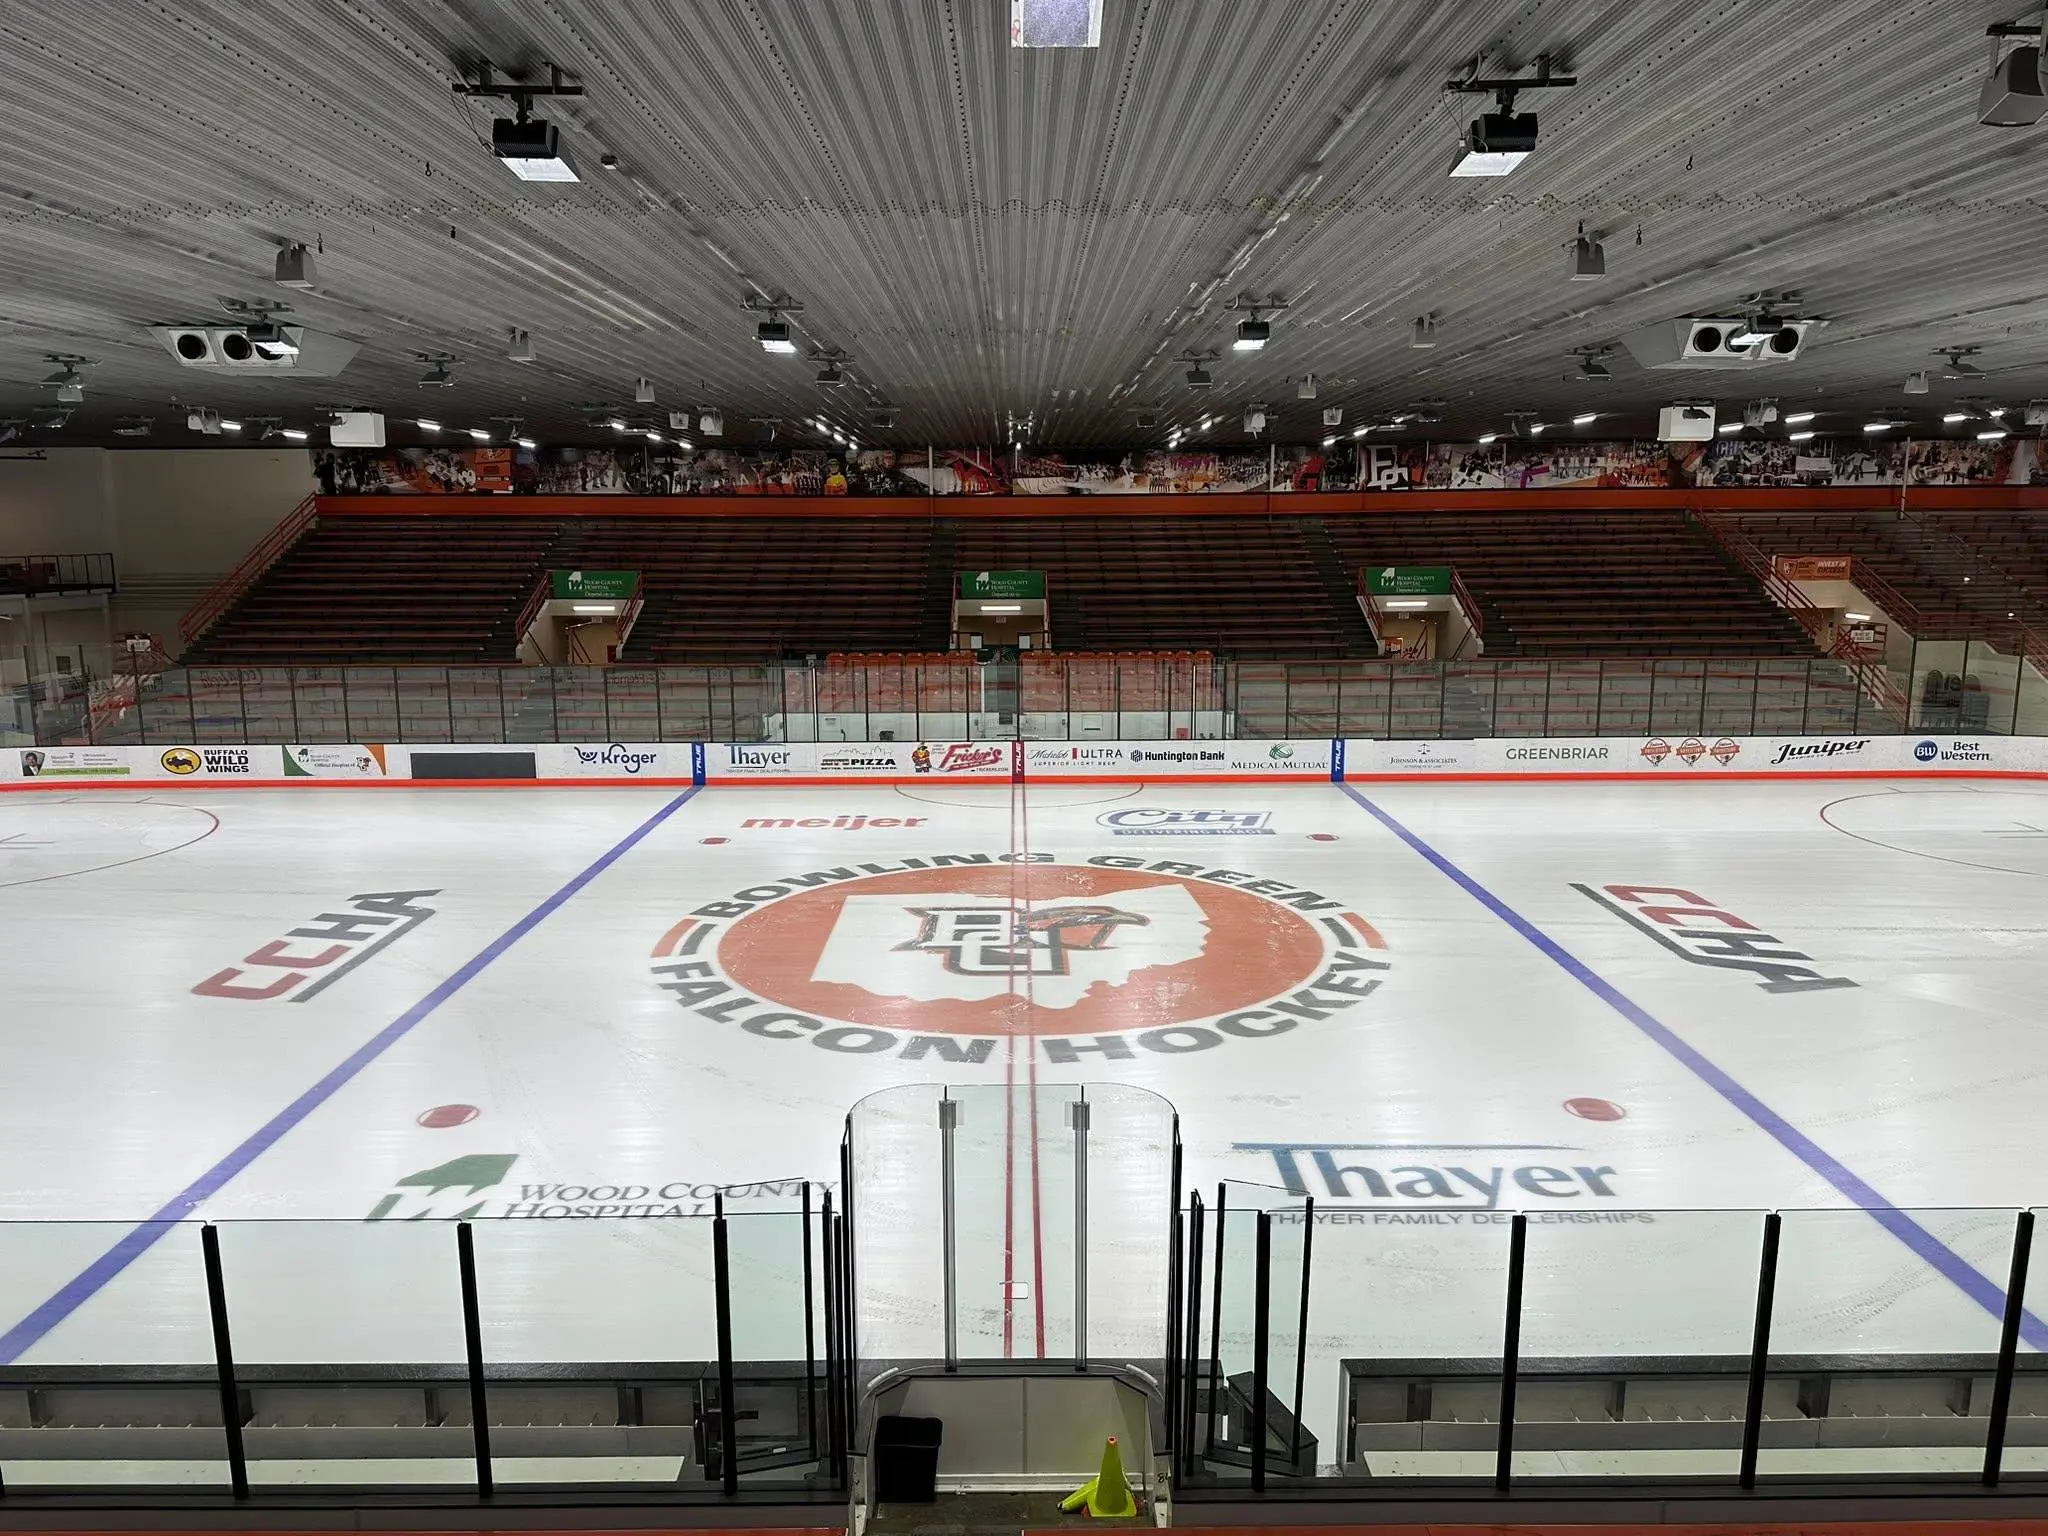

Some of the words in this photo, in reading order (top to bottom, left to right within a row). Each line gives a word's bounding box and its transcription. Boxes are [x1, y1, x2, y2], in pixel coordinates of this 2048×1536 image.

[1027, 749, 1071, 760] Michelob
[1080, 748, 1123, 759] ULTRA
[1505, 747, 1609, 760] GREENBRIAR
[1770, 739, 1871, 765] Juniper
[1916, 745, 1936, 757] BW
[1953, 741, 1980, 751] Best
[204, 755, 249, 765] WILD
[601, 743, 657, 773] Kroger
[696, 744, 704, 775] TRUE
[724, 743, 791, 769] Thayer
[850, 758, 896, 766] PIZZA
[1144, 750, 1198, 763] Huntington
[1199, 750, 1225, 761] Bank
[1940, 751, 1990, 761] Western
[205, 765, 250, 773] WINGS
[1231, 761, 1279, 769] MEDICAL
[1282, 760, 1328, 769] MUTUAL
[740, 815, 928, 831] meijer
[1100, 808, 1270, 830] City
[689, 852, 1055, 918] BOWLING
[1087, 855, 1348, 913] GREEN
[190, 889, 444, 1001] CCHA
[1600, 885, 1861, 994] CCHA
[650, 956, 998, 1064] FALCON
[1041, 950, 1392, 1064] HOCKEY
[1231, 1143, 1617, 1209] Thayer
[520, 1183, 650, 1201] WOOD
[658, 1181, 838, 1201] COUNTY
[502, 1203, 714, 1219] HOSPITAL
[1374, 1213, 1464, 1225] FAMILY
[1472, 1213, 1655, 1225] DELERSHIPS
